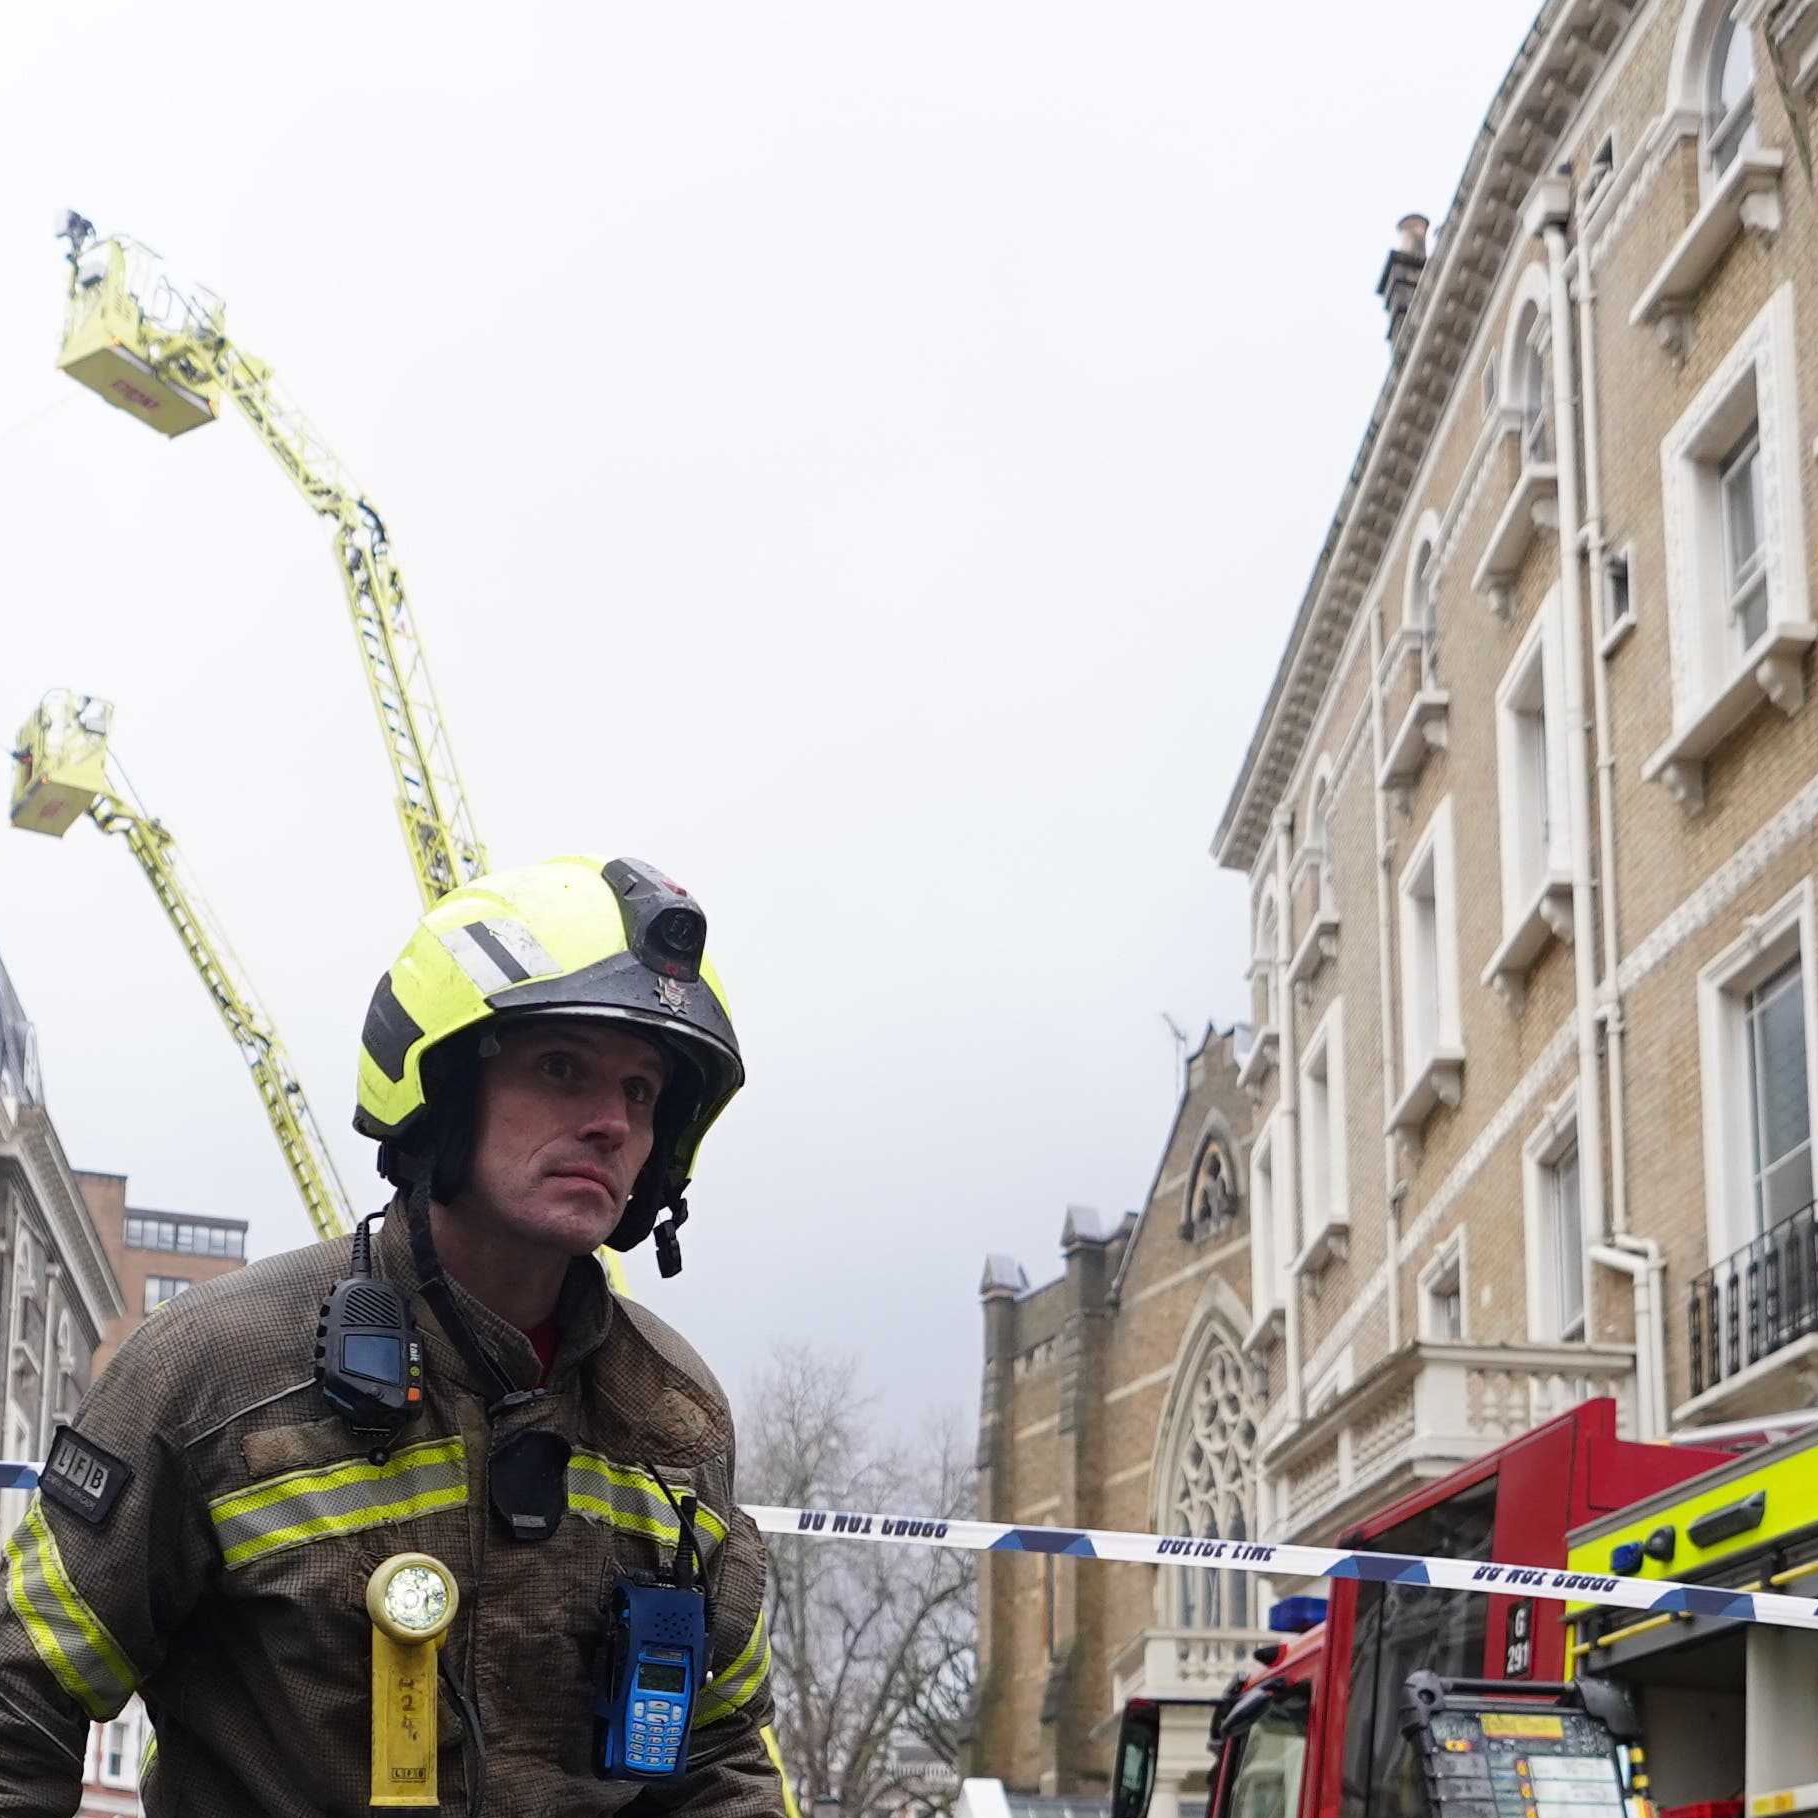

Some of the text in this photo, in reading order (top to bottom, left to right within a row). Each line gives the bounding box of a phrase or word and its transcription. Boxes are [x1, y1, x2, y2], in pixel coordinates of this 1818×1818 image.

[56, 1443, 106, 1492] LFB
[1514, 1607, 1527, 1639] G
[1507, 1640, 1530, 1675] 291
